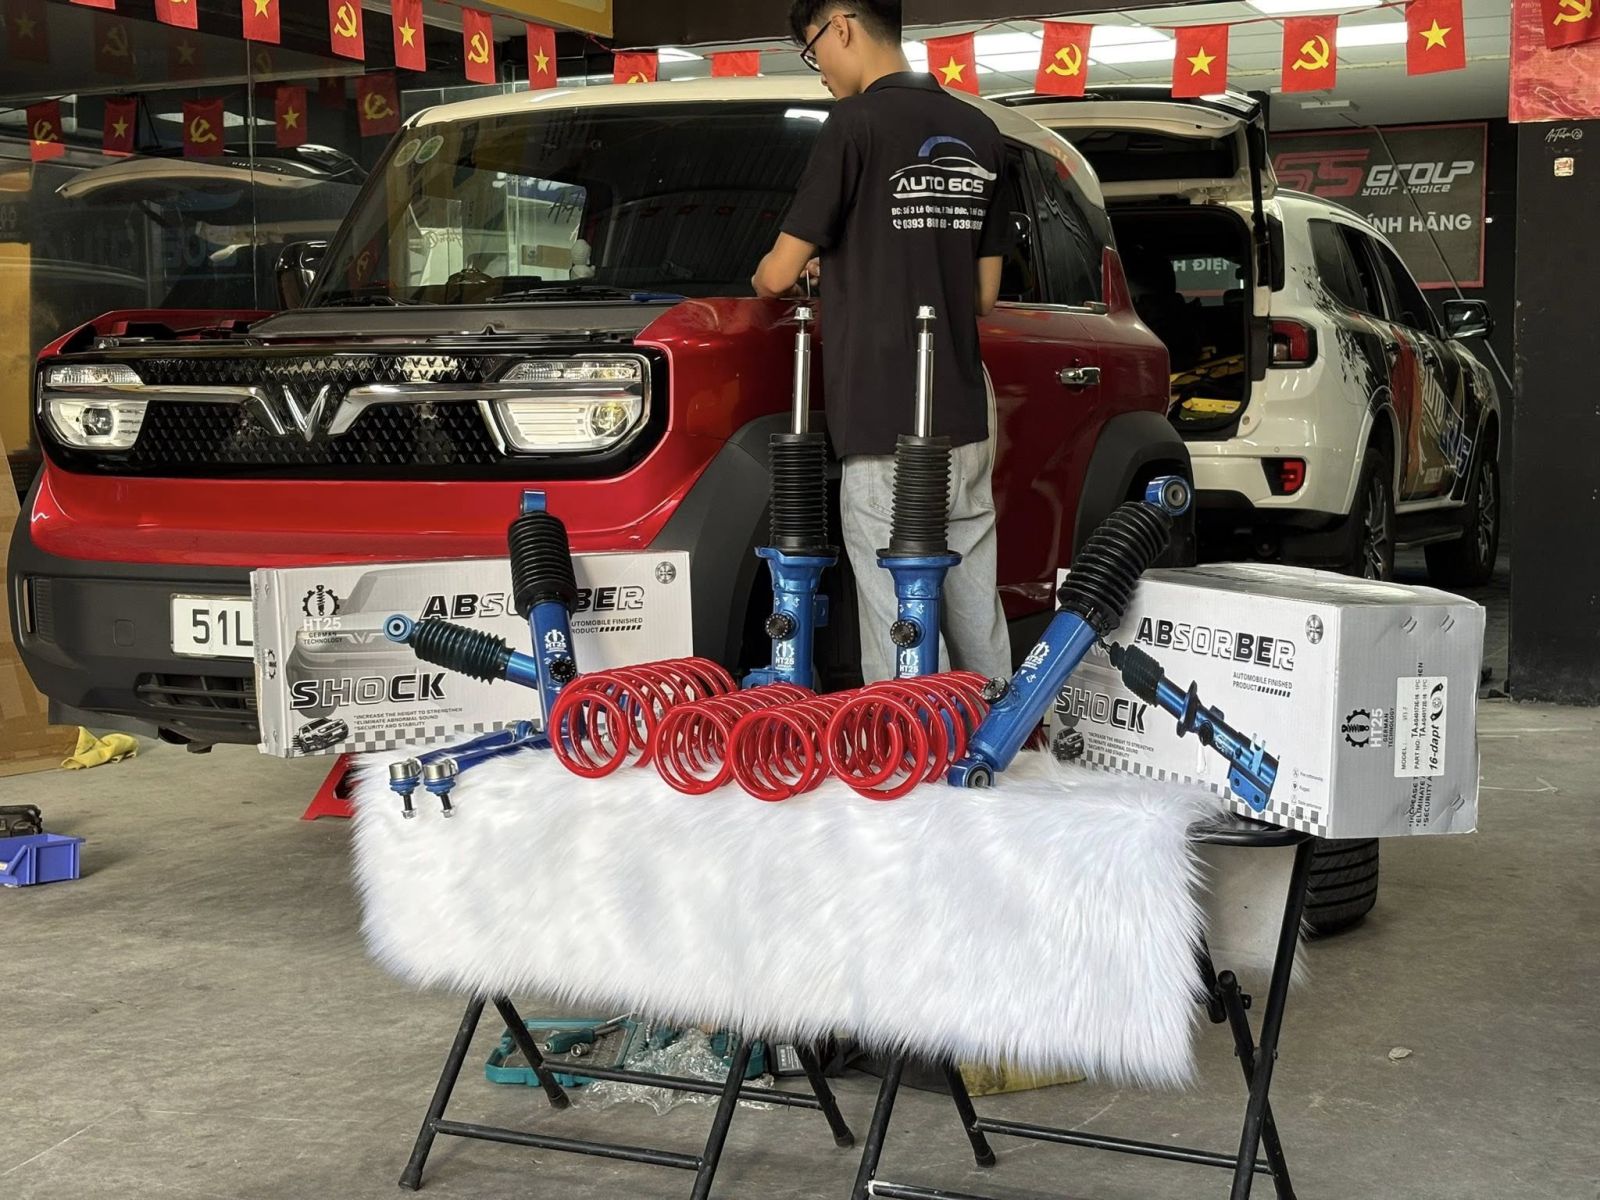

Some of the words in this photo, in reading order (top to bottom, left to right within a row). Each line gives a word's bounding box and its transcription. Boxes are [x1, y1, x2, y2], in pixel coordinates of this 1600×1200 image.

[897, 176, 945, 191] AUTO
[420, 586, 644, 620] ABSBER
[192, 608, 254, 647] 51L
[303, 616, 342, 631] HT25
[572, 618, 611, 627] UTOMOBILE
[612, 617, 643, 626] FINISHED
[1134, 617, 1296, 671] ABSORBER
[290, 672, 448, 710] SHOCK
[1233, 671, 1267, 684] AUTOMOBILE
[1268, 678, 1293, 689] FINISHED
[1054, 685, 1148, 734] SHOCK
[1370, 707, 1384, 748] HT25
